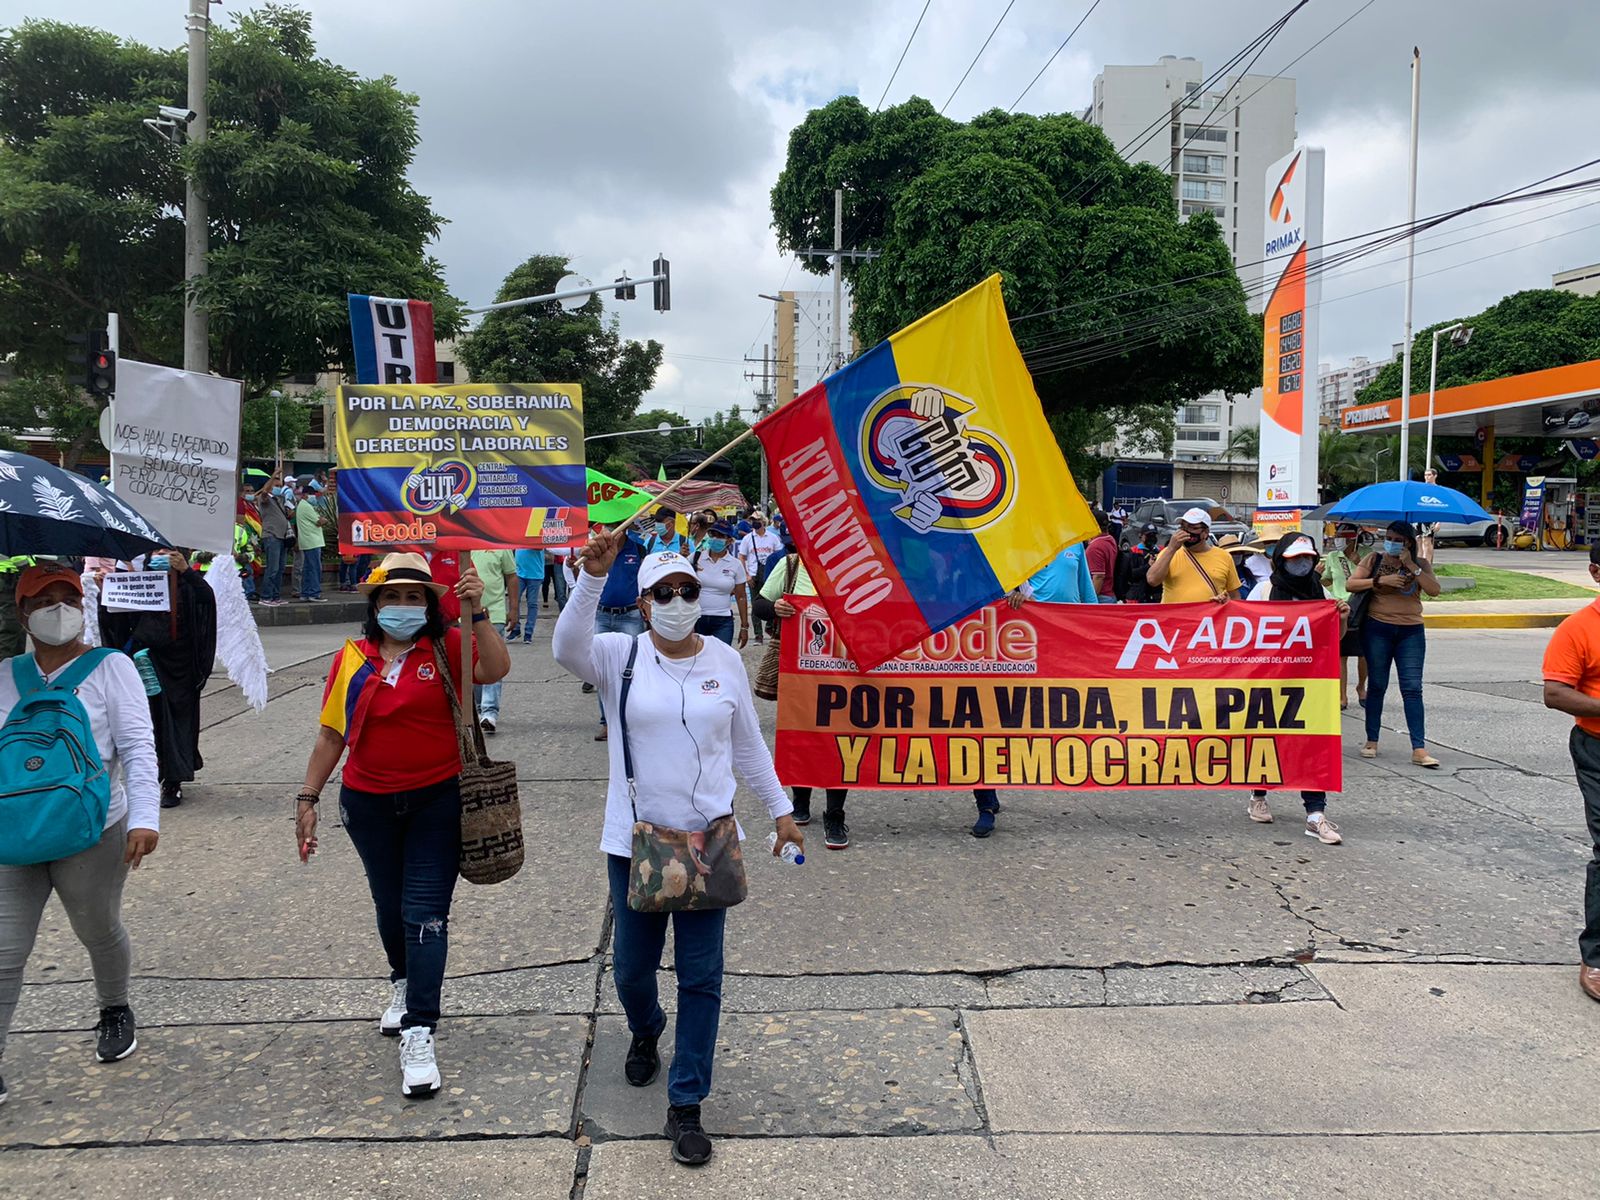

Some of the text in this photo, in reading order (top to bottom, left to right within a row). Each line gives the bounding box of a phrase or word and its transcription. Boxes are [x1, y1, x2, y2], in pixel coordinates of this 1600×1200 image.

[1265, 227, 1301, 257] PRIMAX
[348, 392, 572, 411] POR LA PAZ, SOBERANÍA
[389, 416, 529, 431] DEMOCRACIA Y
[1345, 405, 1390, 424] PRIMAX
[114, 424, 140, 440] NOS
[143, 428, 165, 443] HAN
[120, 439, 204, 466] A VER LAS
[355, 436, 568, 453] DERECHOS LABORALES
[143, 457, 220, 480] BENDICIONES
[478, 463, 507, 472] CENTRAL
[119, 464, 217, 494] PERO NO LAS
[421, 476, 454, 501] CUT
[478, 485, 528, 495] TRABAJADORES
[778, 436, 893, 614] ATLÁNTICO
[1256, 512, 1294, 521] PROMOCION
[363, 518, 437, 542] fecode
[1187, 616, 1313, 649] ADEA
[800, 659, 848, 670] FEDERACIÓN
[900, 663, 910, 672] DE
[911, 663, 968, 671] TRABAJADORES
[970, 663, 980, 671] DE
[981, 663, 992, 671] LA
[992, 661, 1035, 672] EDUCACIÓN
[1232, 656, 1271, 664] EDUCADORES
[1283, 656, 1313, 664] ATLANTICO
[816, 684, 1306, 734] POR LA VIDA, LA PAZ
[835, 736, 1283, 786] Y LA DEMOCRACIA
